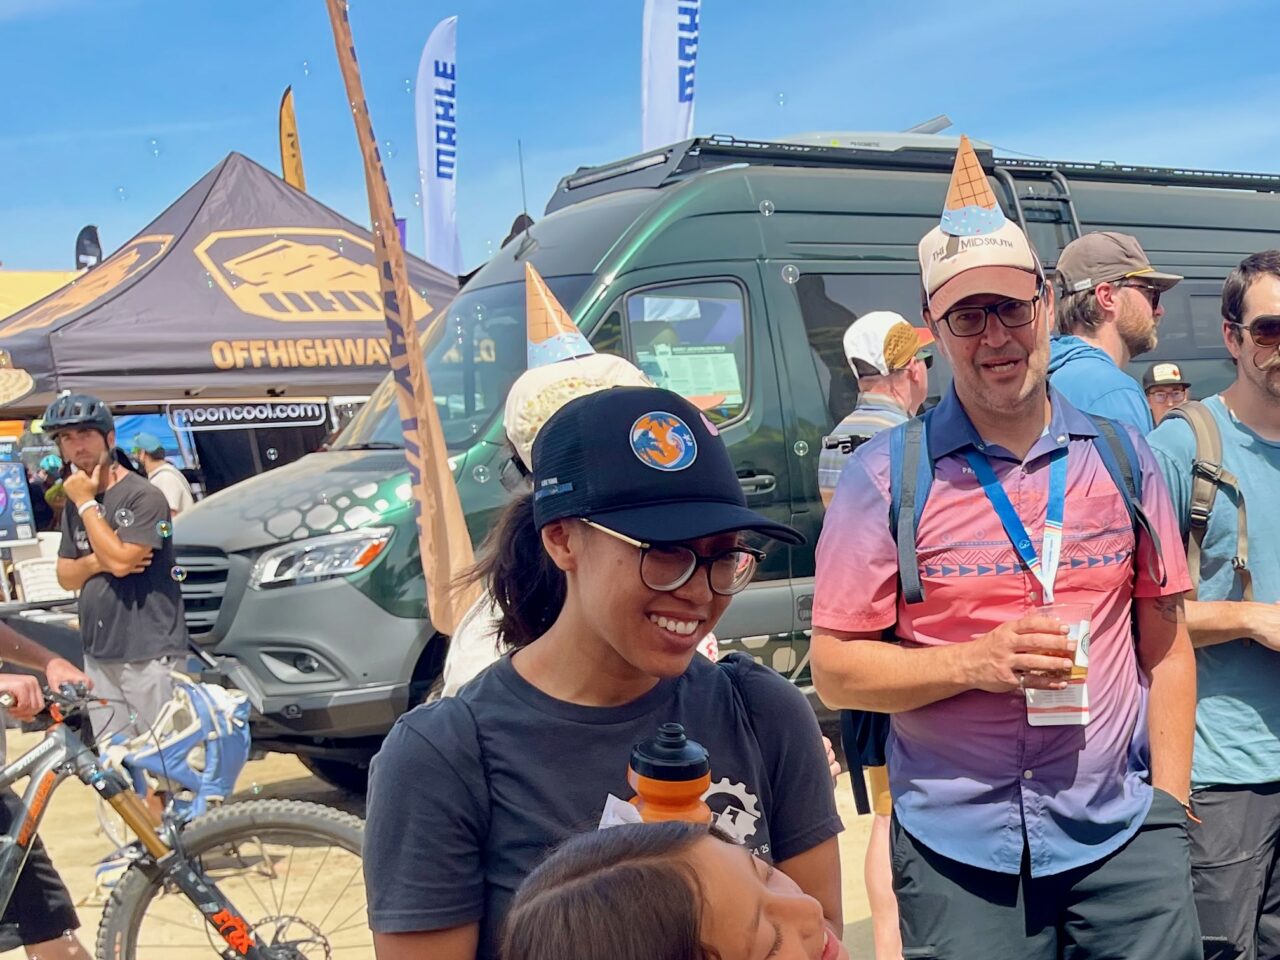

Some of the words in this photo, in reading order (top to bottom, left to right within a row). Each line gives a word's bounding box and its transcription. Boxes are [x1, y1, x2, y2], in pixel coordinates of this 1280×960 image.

[678, 0, 699, 103] MAH
[434, 60, 456, 179] MAHLE
[173, 403, 320, 423] mooncool.com
